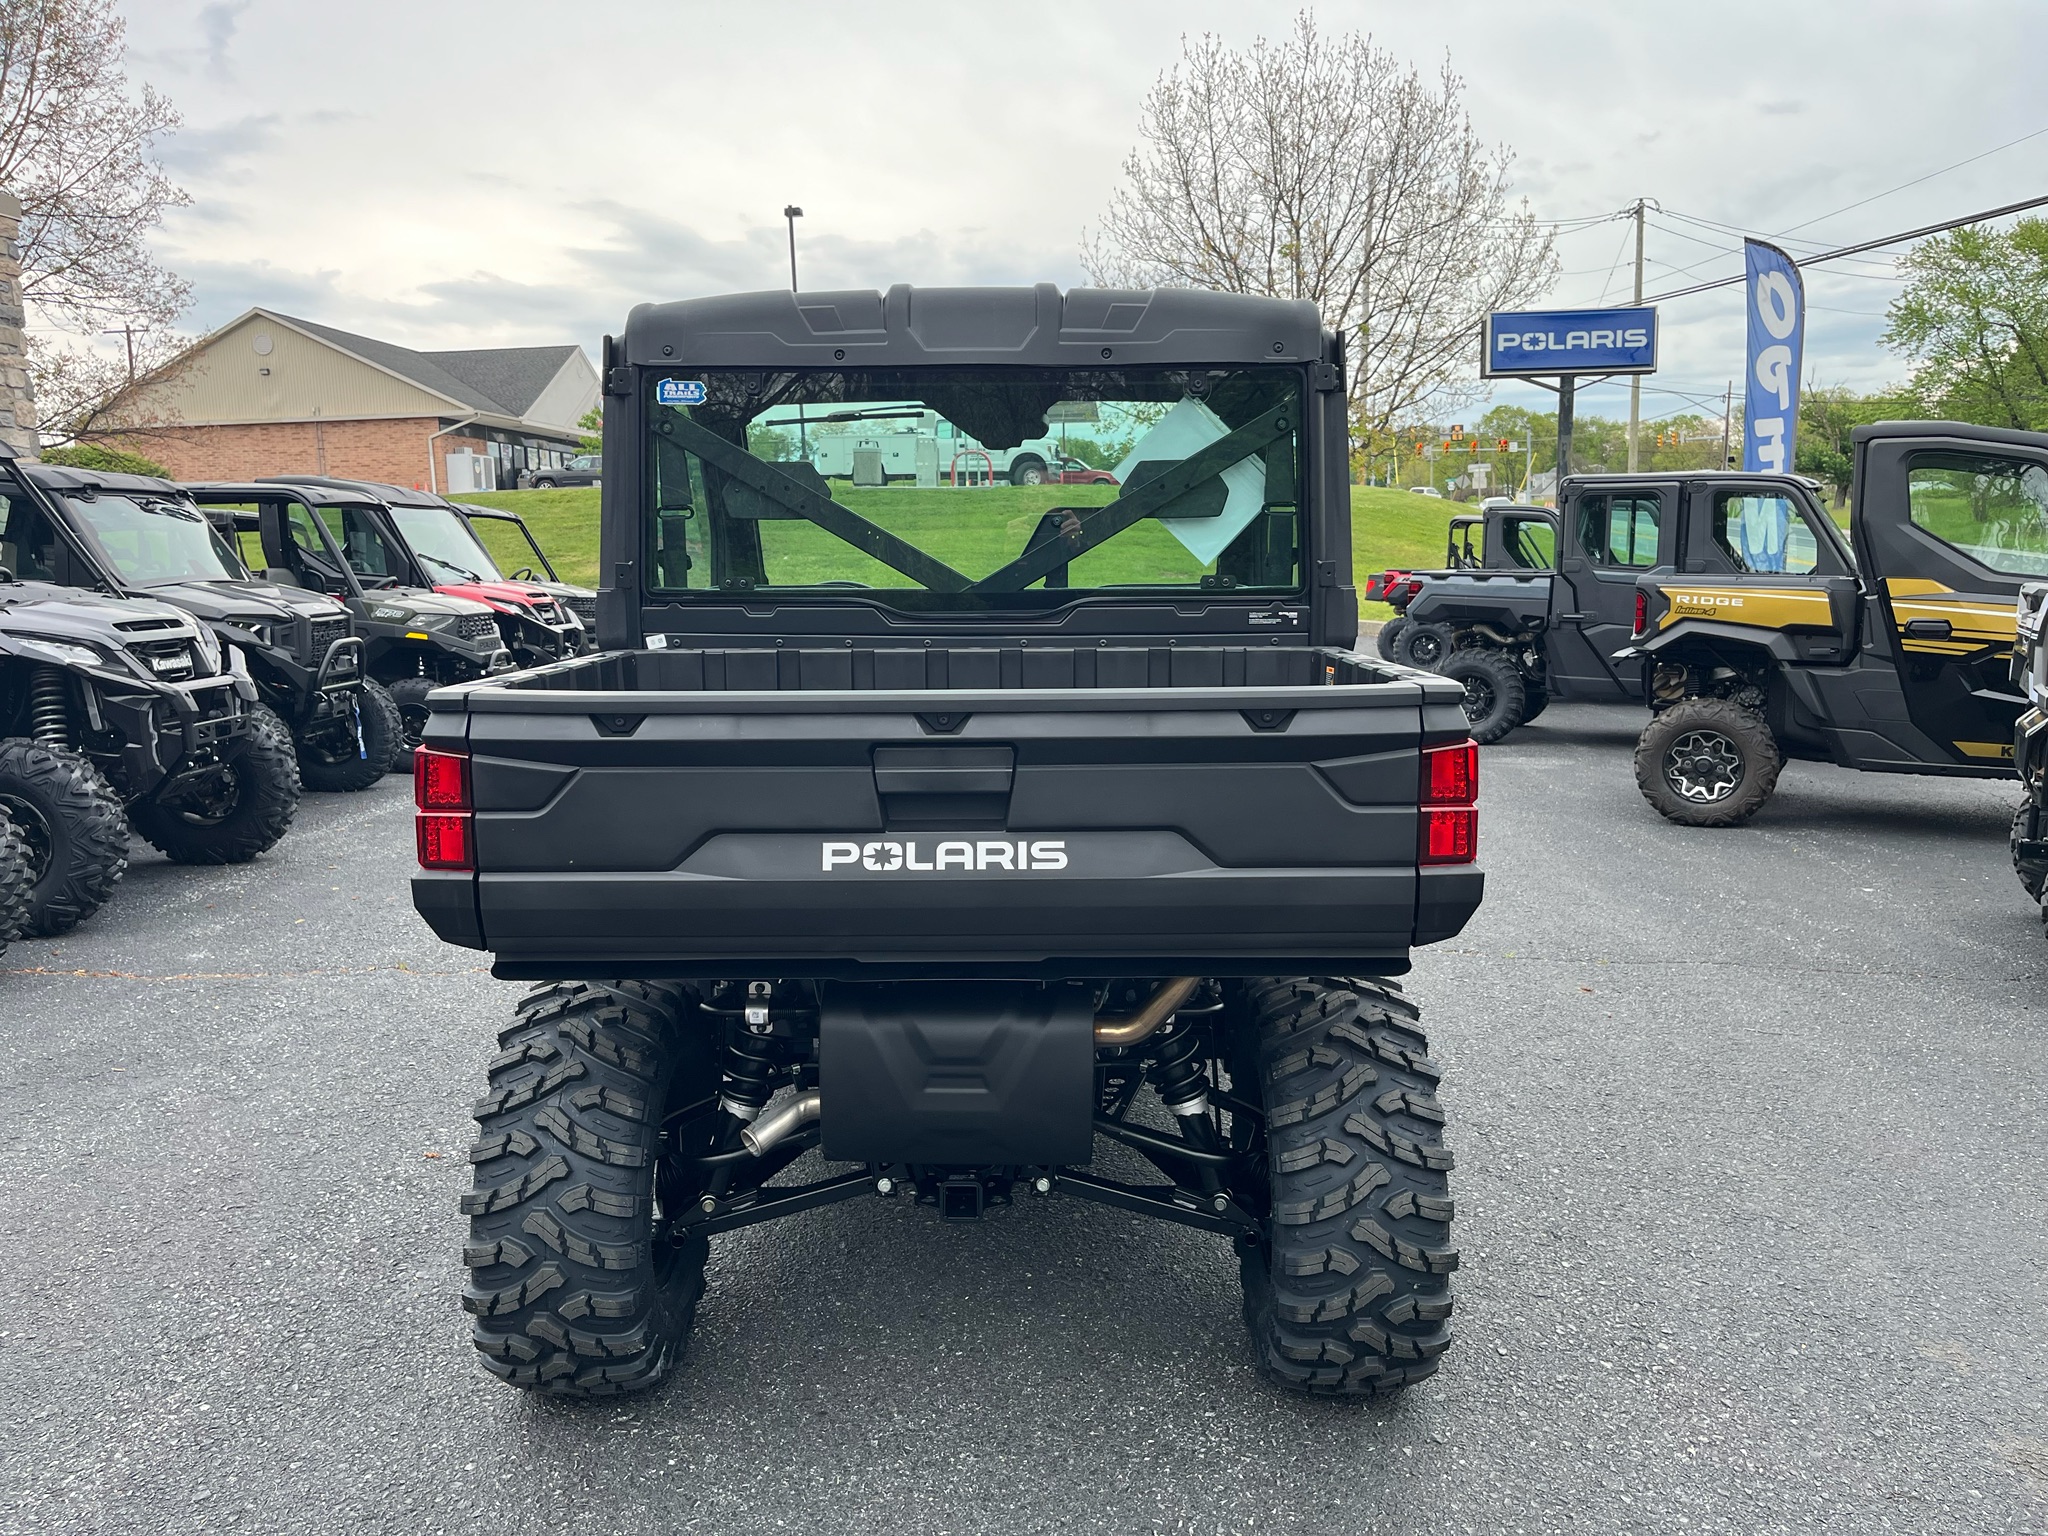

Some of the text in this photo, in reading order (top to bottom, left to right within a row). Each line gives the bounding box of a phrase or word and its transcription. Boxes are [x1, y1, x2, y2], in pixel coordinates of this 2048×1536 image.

[1497, 328, 1649, 352] POLARIS
[663, 383, 698, 391] ALL
[1676, 595, 1744, 607] RIDGE
[151, 654, 193, 672] Kawasaki
[822, 840, 1069, 872] POLARIS
